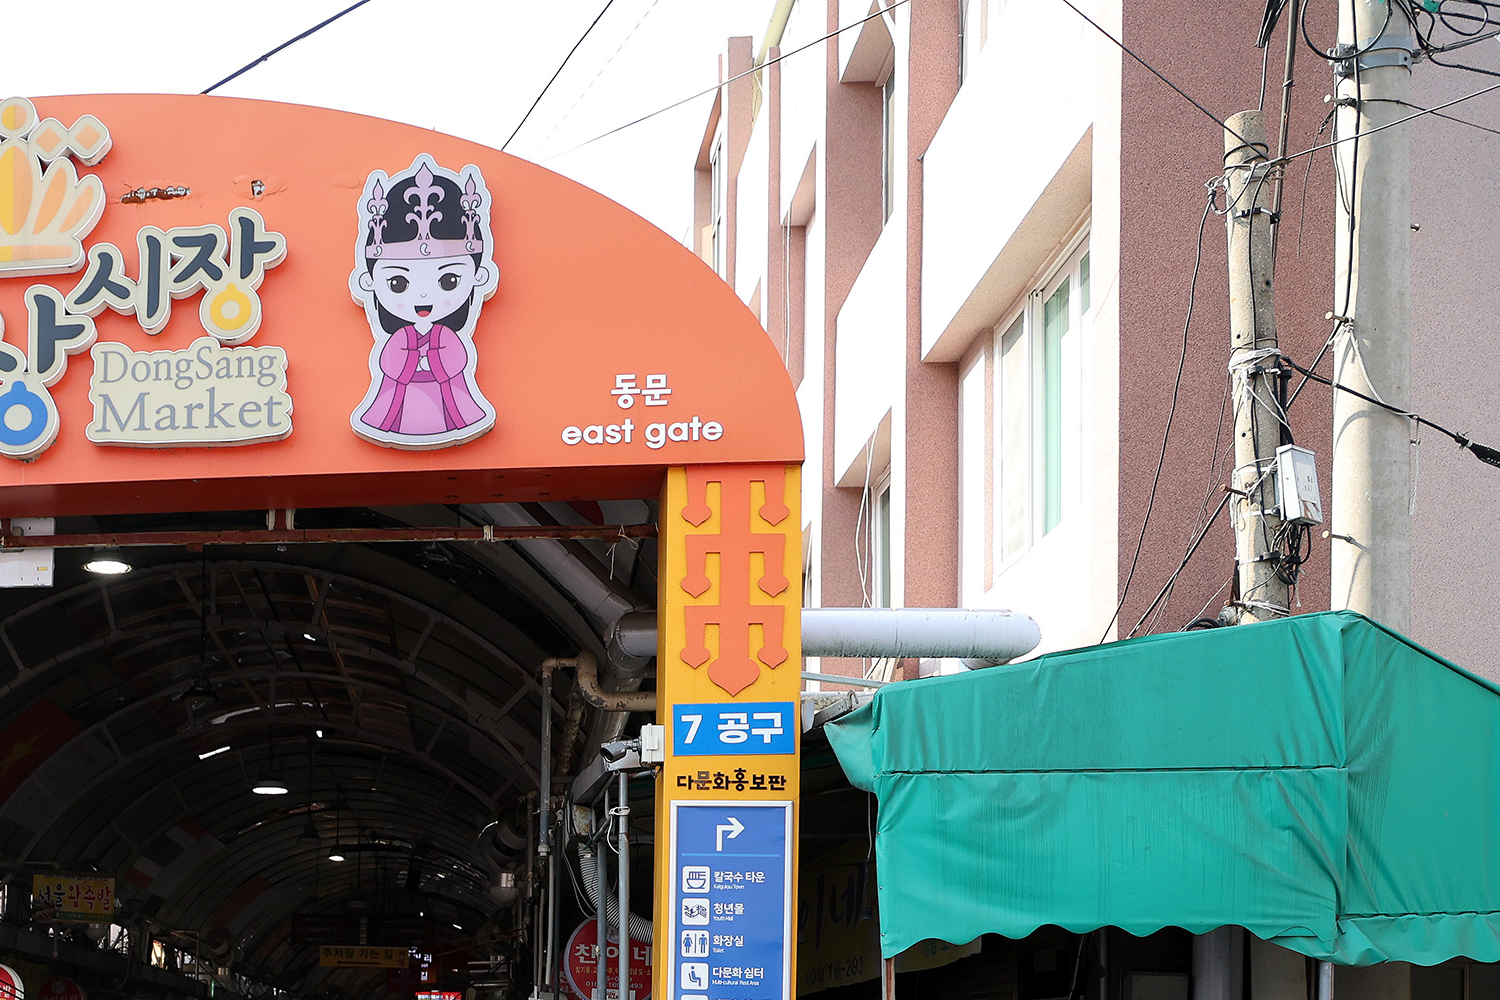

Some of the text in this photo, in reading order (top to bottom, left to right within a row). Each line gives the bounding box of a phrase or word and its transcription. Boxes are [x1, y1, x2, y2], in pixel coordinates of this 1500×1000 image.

[100, 344, 277, 391] DongSang
[611, 373, 673, 408] 동문
[95, 391, 283, 434] Market
[561, 416, 724, 449] east gate
[680, 711, 784, 745] 7 공구
[676, 767, 787, 792] 다문화홍보판
[713, 871, 766, 883] 칼국수 타운
[37, 883, 112, 911] 서울왕족발
[713, 903, 745, 915] 청년몰
[712, 935, 744, 947] 화장실
[712, 967, 764, 979] 다문화 쉼터
